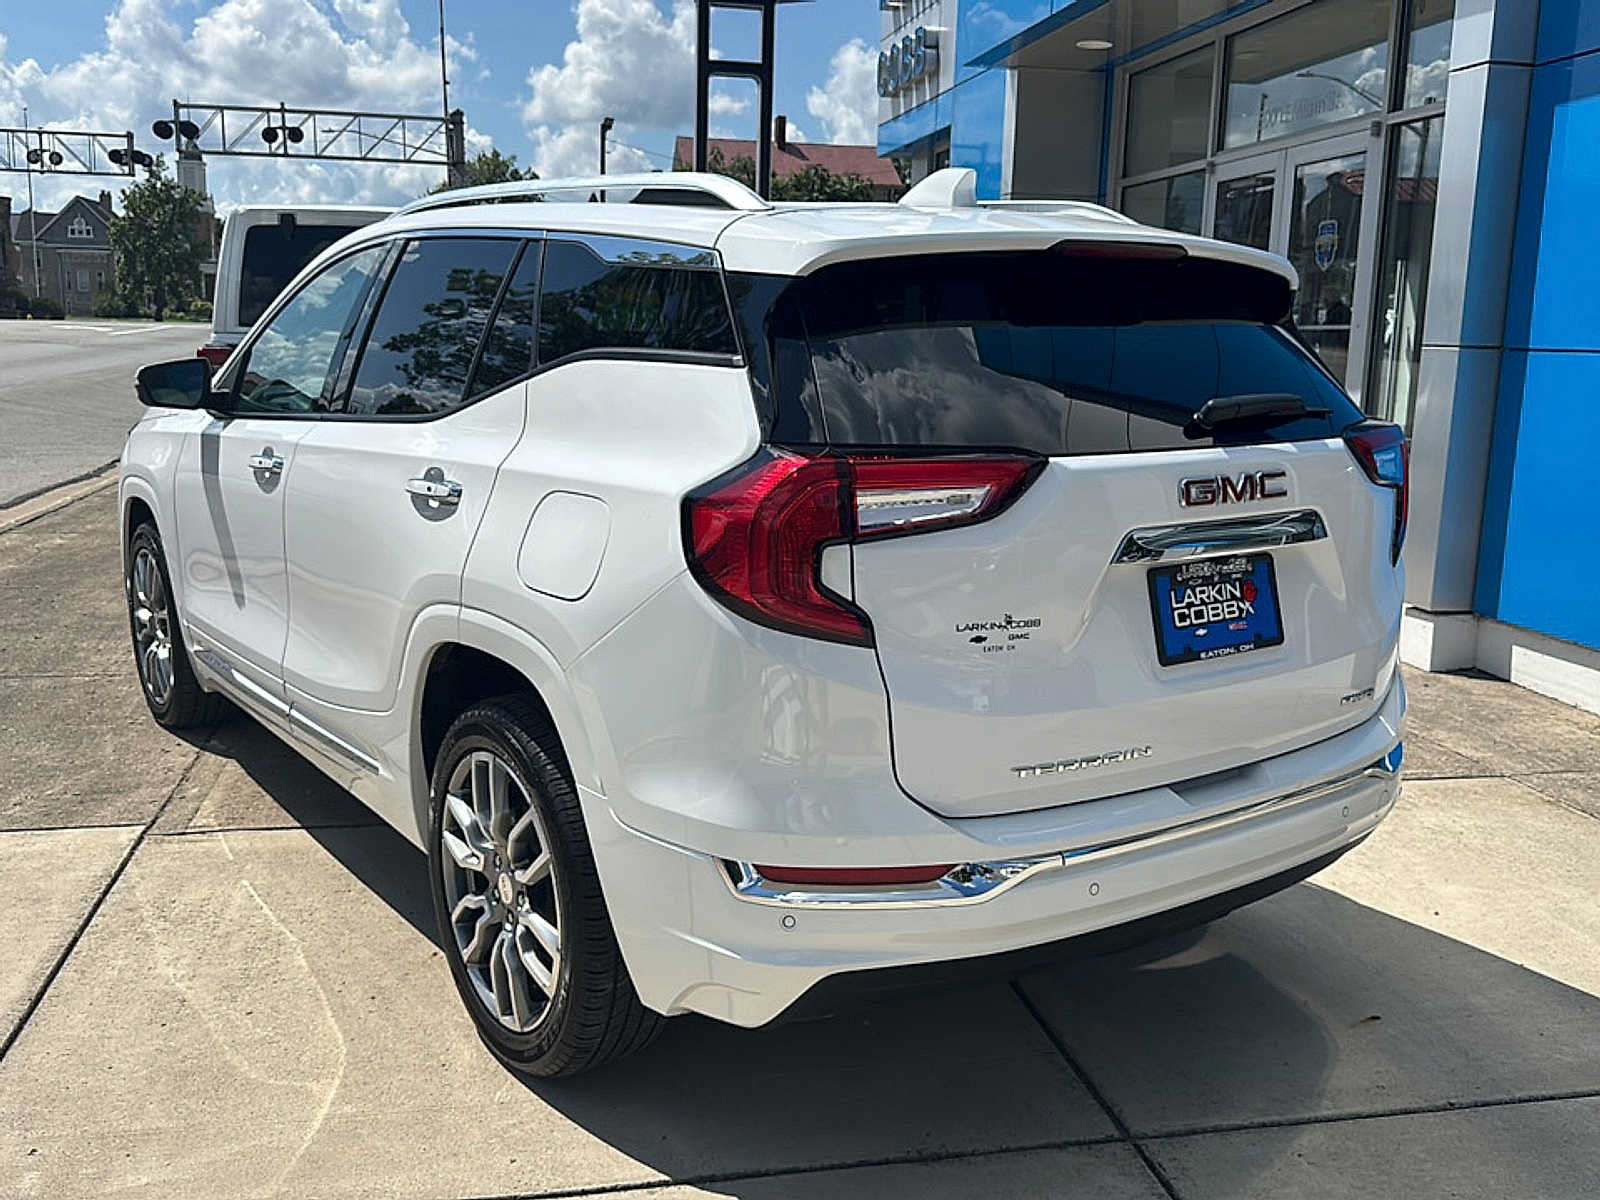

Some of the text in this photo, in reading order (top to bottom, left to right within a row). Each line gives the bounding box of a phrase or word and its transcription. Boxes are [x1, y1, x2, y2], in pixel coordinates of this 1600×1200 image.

[877, 26, 928, 97] COBB
[1178, 470, 1288, 508] GMC
[1170, 581, 1241, 608] LARKIN
[956, 621, 1004, 633] LARKIN
[1173, 600, 1240, 628] COBB
[1008, 633, 1030, 641] GMC
[1200, 643, 1256, 659] EATON, OH
[1011, 745, 1152, 778] TERRAIN
